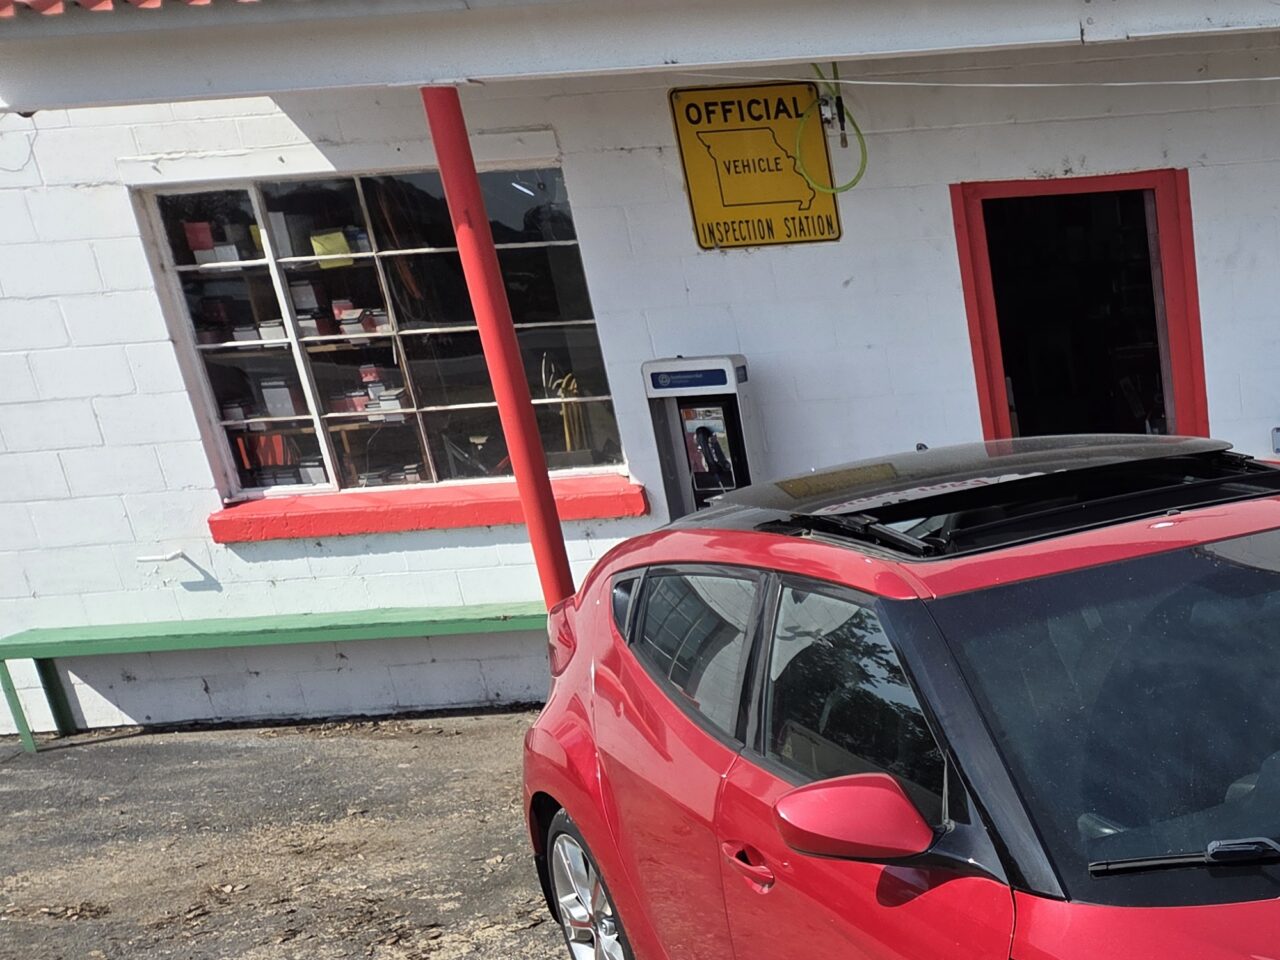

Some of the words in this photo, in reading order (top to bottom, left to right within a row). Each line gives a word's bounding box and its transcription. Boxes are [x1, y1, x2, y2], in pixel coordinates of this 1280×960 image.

[685, 97, 804, 125] OFFICIAL
[723, 157, 783, 175] VEHICLE
[701, 216, 774, 244] INSPECTION
[783, 214, 834, 238] STATION
